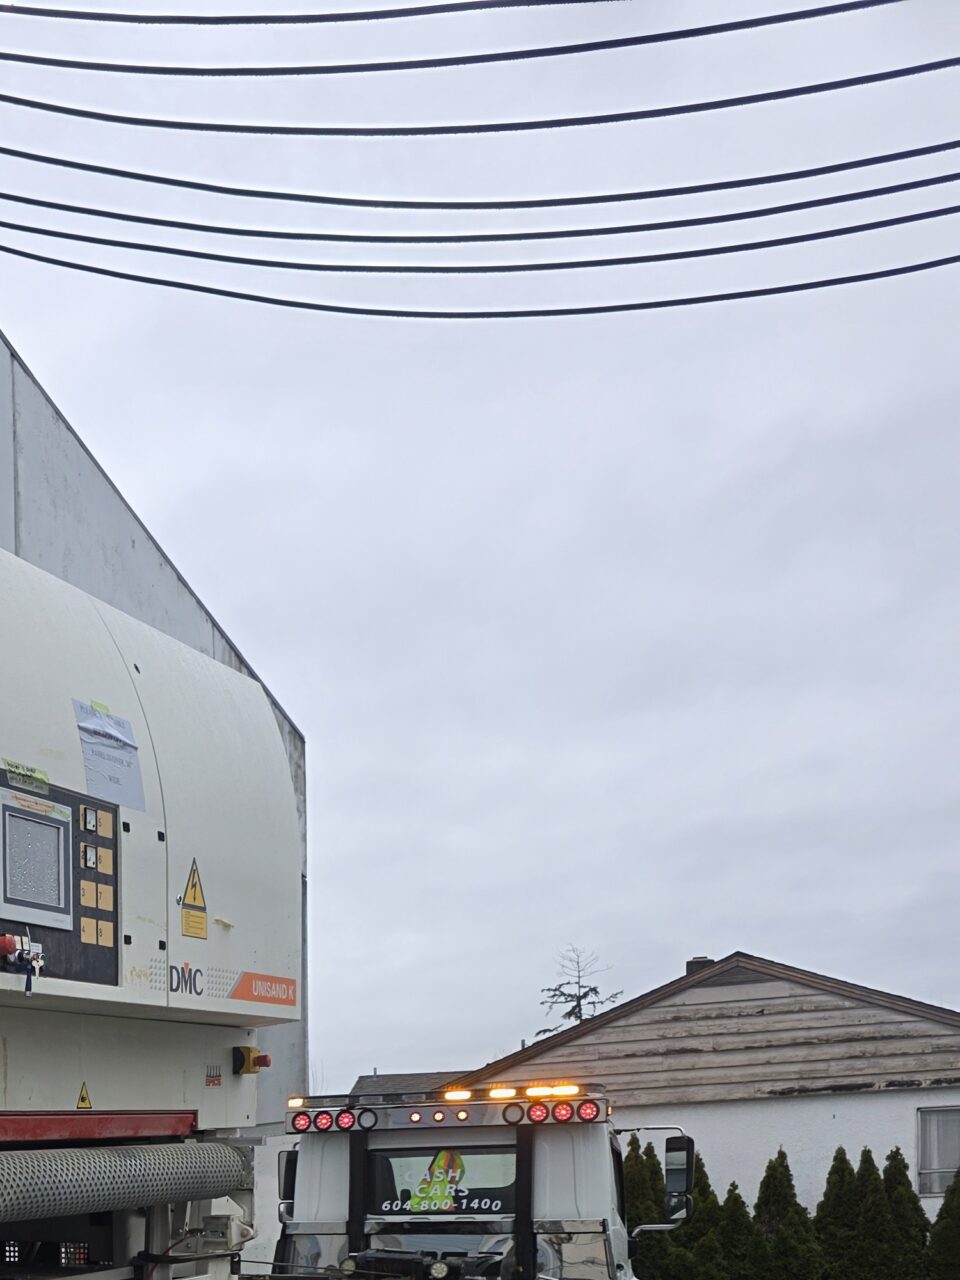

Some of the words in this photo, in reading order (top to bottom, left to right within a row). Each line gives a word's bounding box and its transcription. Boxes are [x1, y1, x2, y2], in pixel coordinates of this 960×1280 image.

[169, 964, 204, 997] DMC
[252, 979, 288, 1000] UNISAND
[288, 985, 295, 1001] K
[405, 1168, 461, 1182] CASH
[415, 1184, 470, 1197] CARS
[381, 1198, 502, 1211] 604-800-1400
